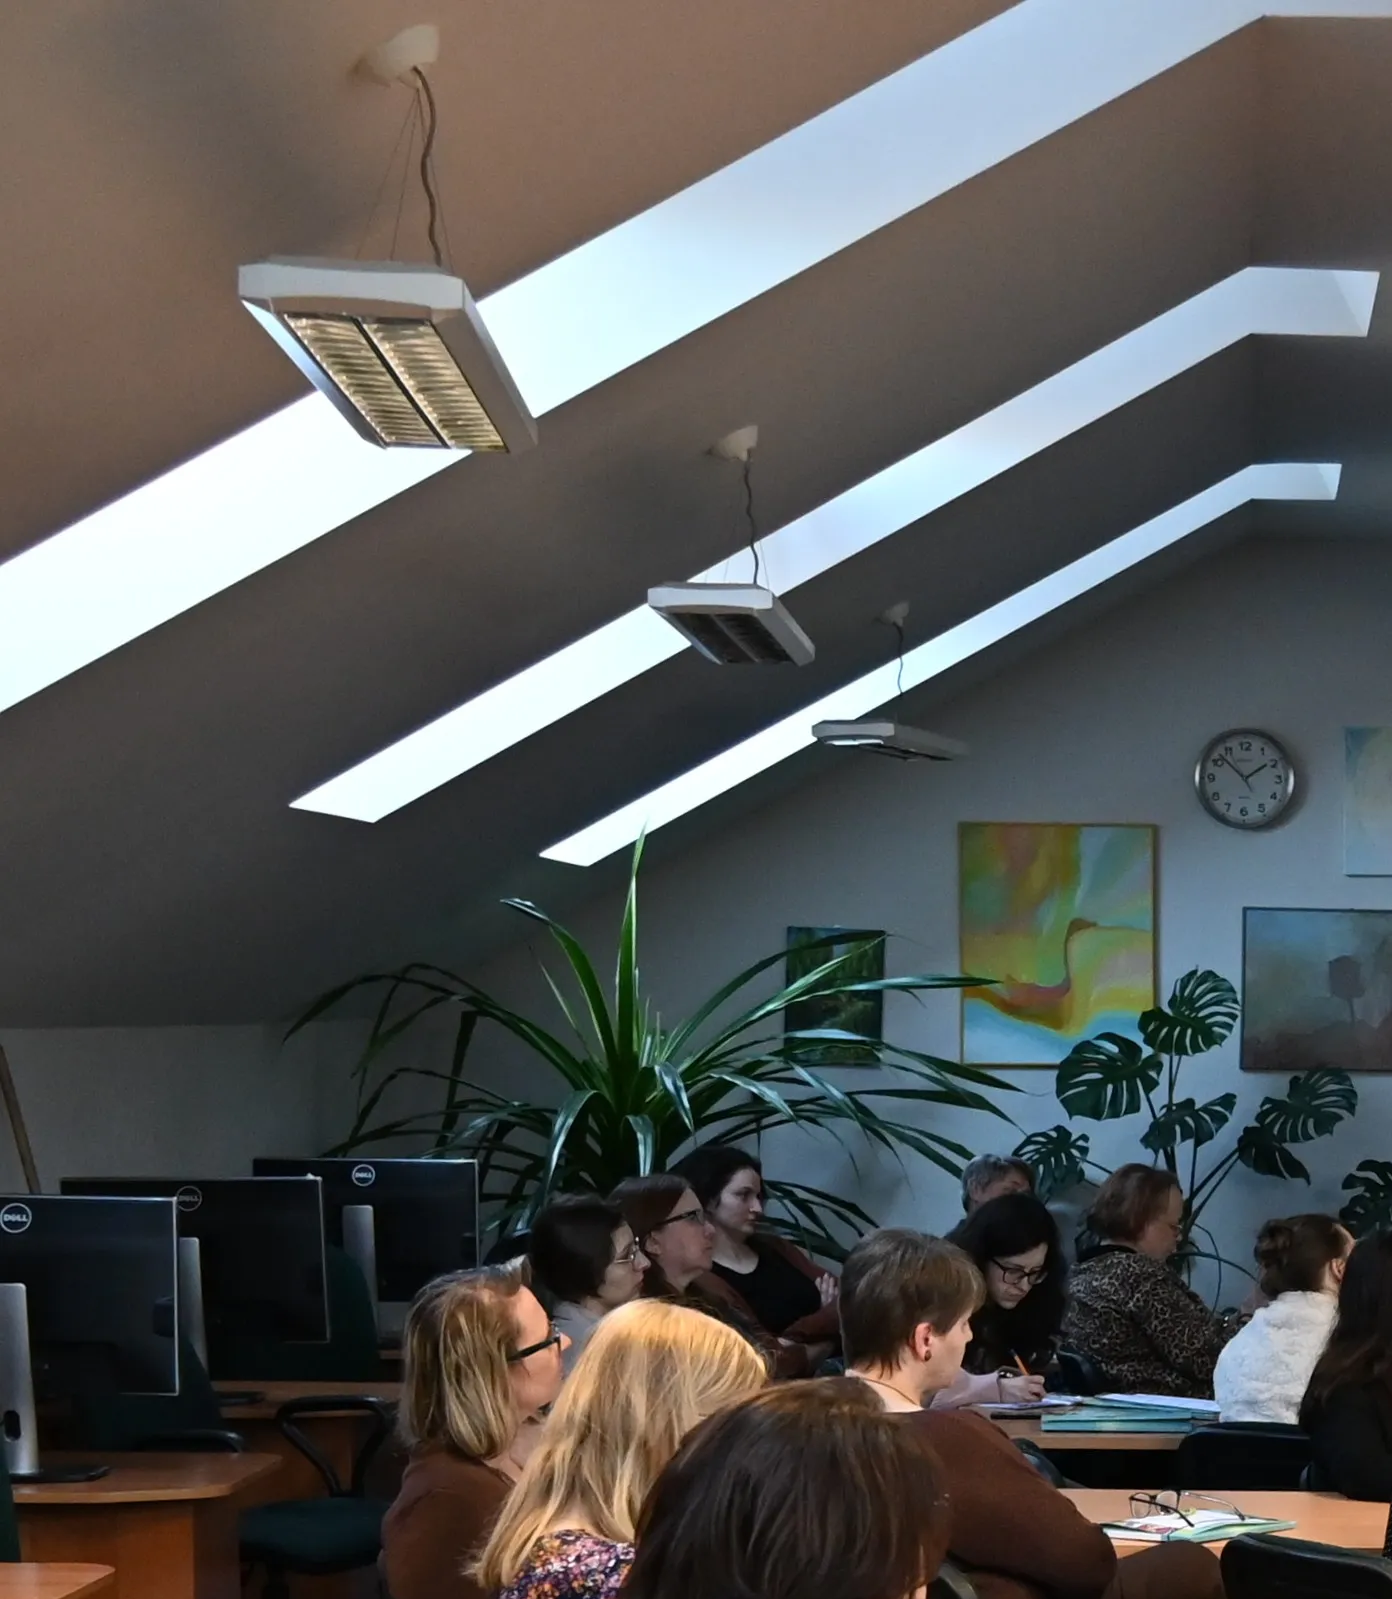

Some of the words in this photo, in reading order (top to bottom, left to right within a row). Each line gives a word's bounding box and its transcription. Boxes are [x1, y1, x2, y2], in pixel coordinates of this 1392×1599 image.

[1224, 746, 1232, 756] 11
[1239, 741, 1252, 751] 12
[1212, 757, 1224, 767] 10
[1270, 758, 1278, 768] 2
[1207, 773, 1215, 783] 9
[1274, 775, 1283, 784] 3
[1212, 792, 1220, 801] 8
[1270, 792, 1277, 800] 4
[1224, 802, 1231, 812] 7
[1239, 806, 1248, 816] 6
[1257, 803, 1265, 813] 5
